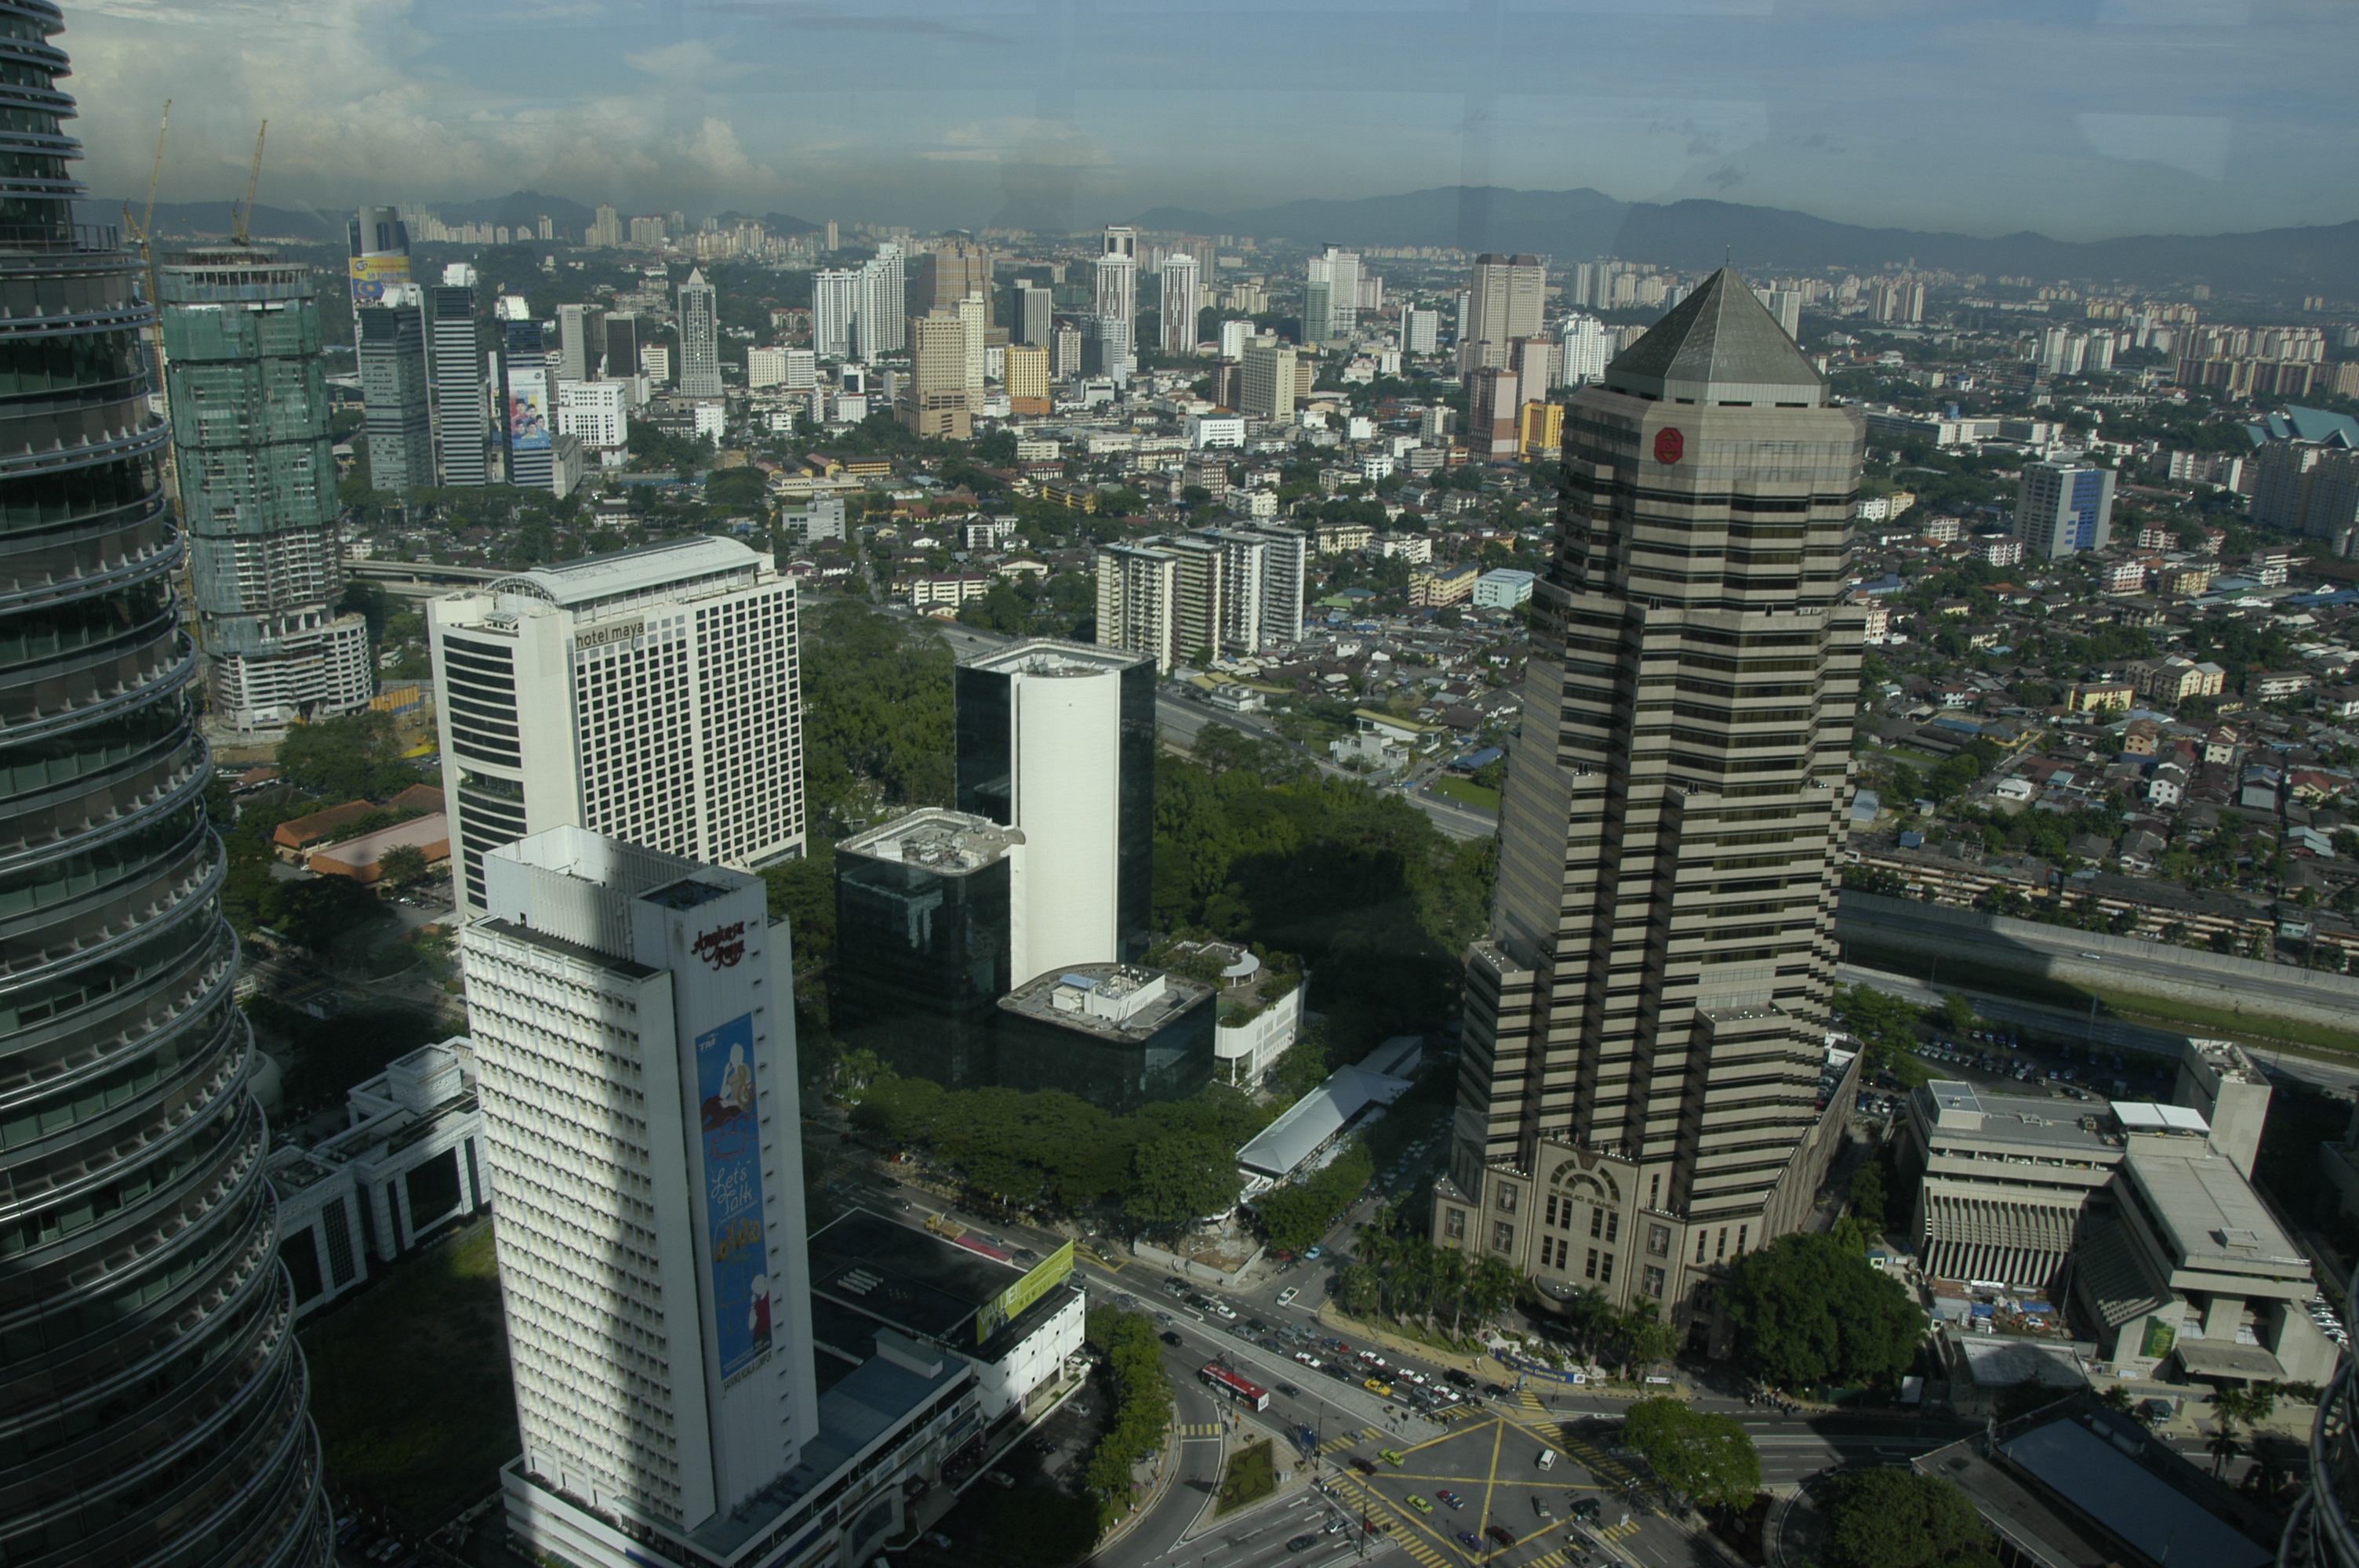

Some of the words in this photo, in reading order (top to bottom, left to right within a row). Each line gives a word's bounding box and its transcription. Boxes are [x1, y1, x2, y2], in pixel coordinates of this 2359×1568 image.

[576, 627, 609, 648] hotel
[612, 622, 644, 651] maya
[699, 1037, 717, 1052] TM
[711, 1161, 747, 1199] Let's
[718, 1181, 753, 1215] Talk
[1550, 1187, 1584, 1202] PUBLIC
[1587, 1197, 1617, 1211] BANK
